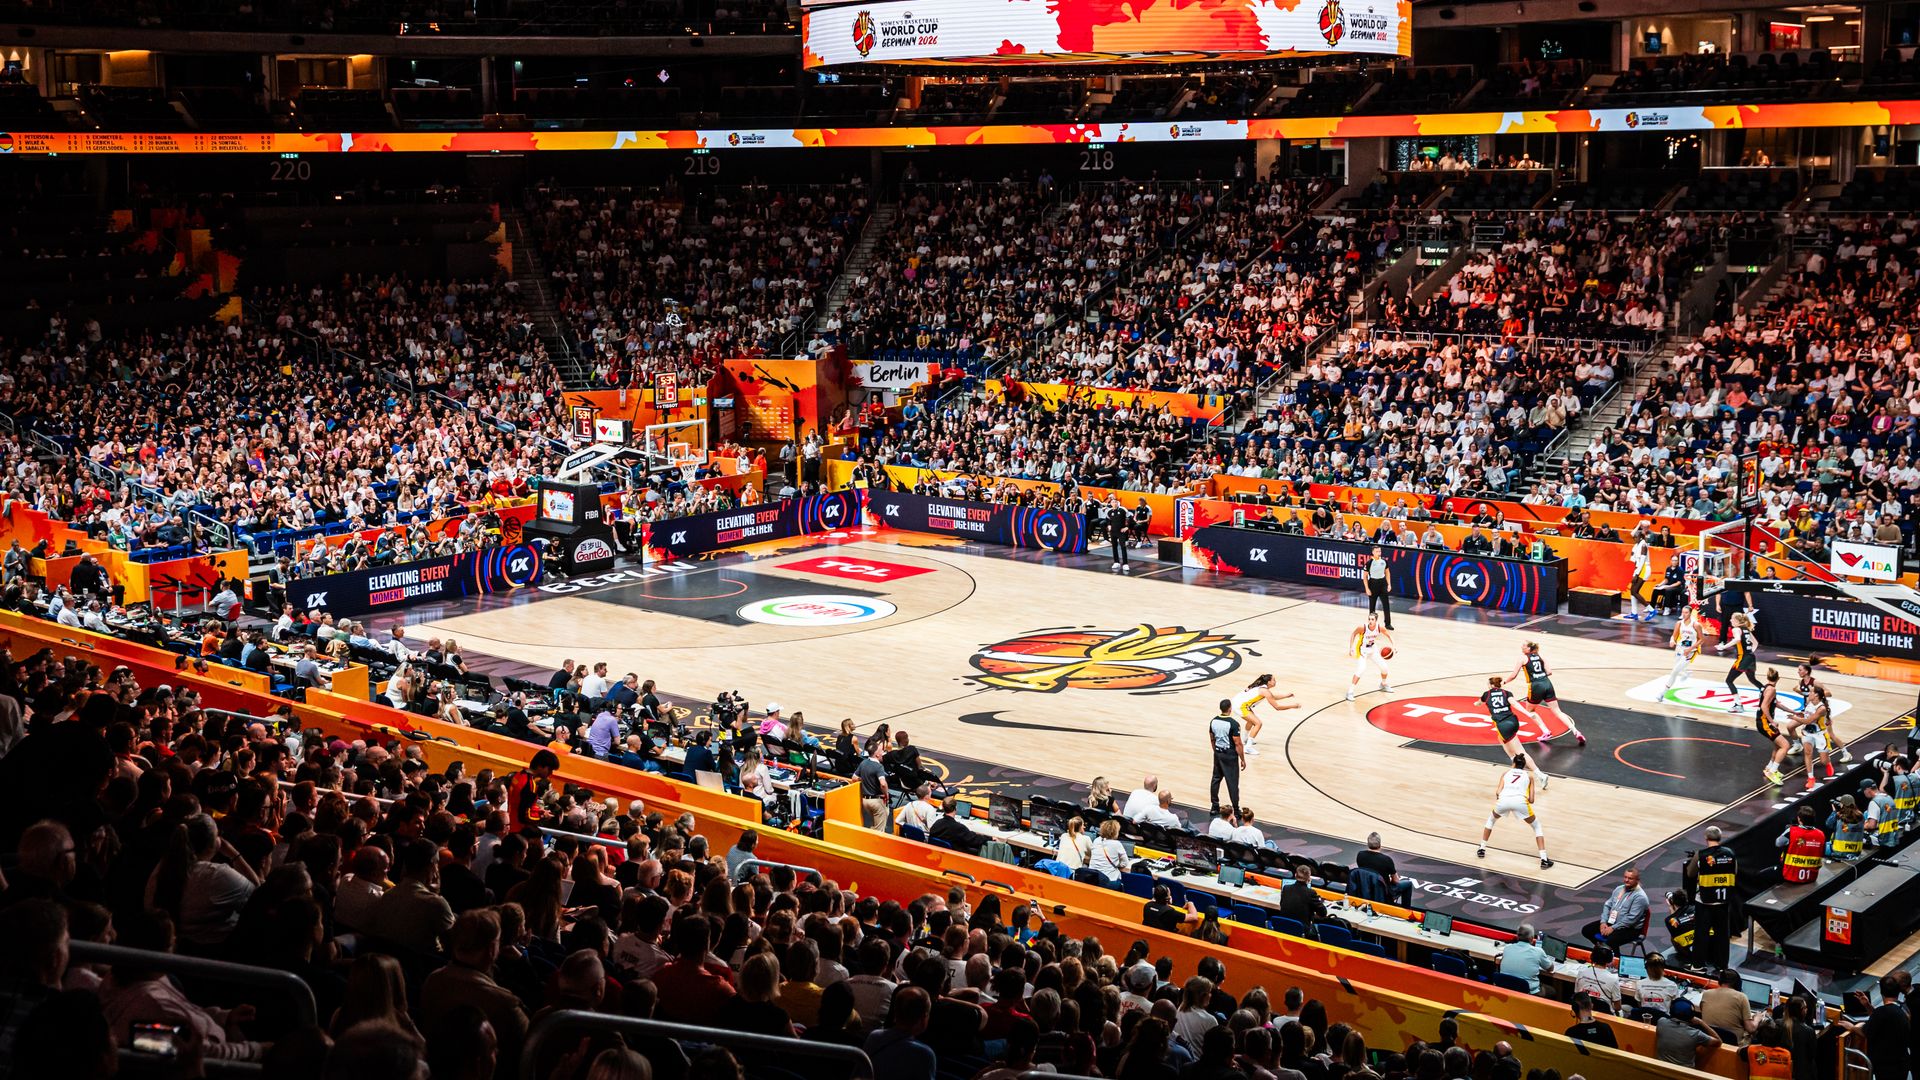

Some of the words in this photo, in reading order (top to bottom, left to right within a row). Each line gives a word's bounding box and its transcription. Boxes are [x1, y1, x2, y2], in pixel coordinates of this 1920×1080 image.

[881, 24, 916, 36] WORLD
[917, 23, 938, 34] CUP
[1350, 18, 1376, 30] WORLD
[1376, 20, 1388, 30] CUP
[882, 37, 917, 48] GERMANY
[918, 36, 938, 46] 2026
[1350, 30, 1376, 40] GERMANY
[684, 156, 720, 175] 219
[1079, 151, 1114, 170] 218
[270, 161, 311, 180] 220
[870, 364, 919, 382] Berlin
[666, 386, 674, 400] 6
[582, 421, 590, 435] 6
[585, 510, 599, 520] FIBA
[716, 513, 755, 530] ELEVATING
[756, 509, 779, 524] EVERY
[928, 504, 966, 519] ELEVATING
[967, 508, 992, 522] EVERY
[930, 518, 953, 529] MOMENT
[719, 529, 742, 542] MOMENT
[576, 548, 610, 562] Ganten
[1306, 548, 1356, 566] ELEVATING
[817, 560, 891, 577] TCL
[1308, 565, 1339, 577] MOMENT
[1862, 560, 1892, 573] AIDA
[369, 570, 419, 591] ELEVATING
[420, 564, 450, 582] EVERY
[537, 561, 698, 594] BERLIN
[372, 589, 403, 604] MOMENT
[1812, 608, 1880, 630] ELEVATING
[1883, 616, 1920, 635] EVER
[1814, 628, 1857, 644] MOMENT
[1532, 661, 1542, 672] 21
[1491, 697, 1504, 708] 24
[1511, 774, 1521, 784] 7
[1798, 869, 1811, 880] 01
[1399, 876, 1540, 914] NCKERS
[1715, 888, 1727, 900] 11
